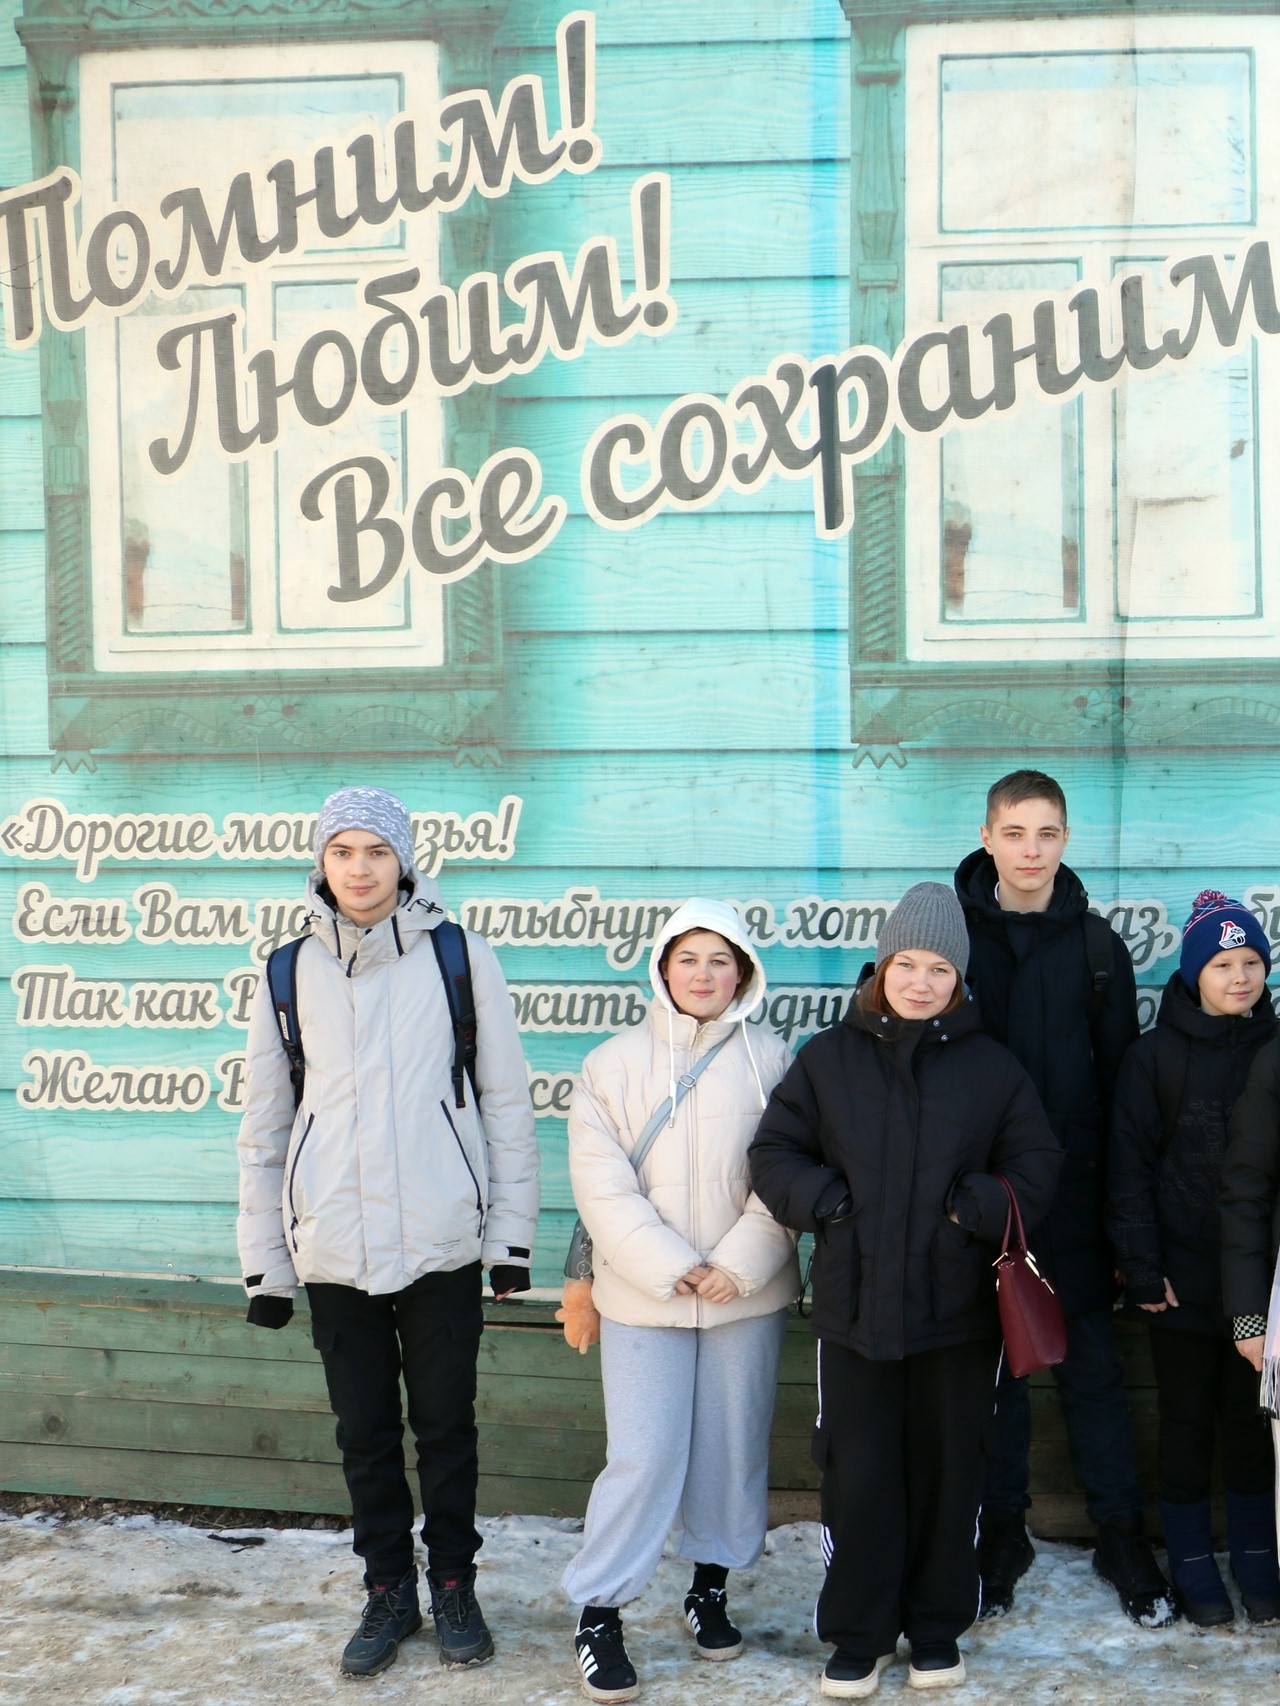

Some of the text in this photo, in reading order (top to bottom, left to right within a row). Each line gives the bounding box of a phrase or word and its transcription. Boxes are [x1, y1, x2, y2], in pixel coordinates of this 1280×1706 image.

[0, 19, 594, 341] Помним!
[149, 181, 669, 475] Любим!
[300, 456, 558, 603] Все
[1, 805, 213, 875] «Дорогие
[18, 888, 126, 937] Если
[138, 888, 248, 938] Вам
[786, 902, 886, 942] хот
[17, 971, 123, 1021] Так
[134, 988, 216, 1021] как
[22, 1055, 204, 1106] Желаю
